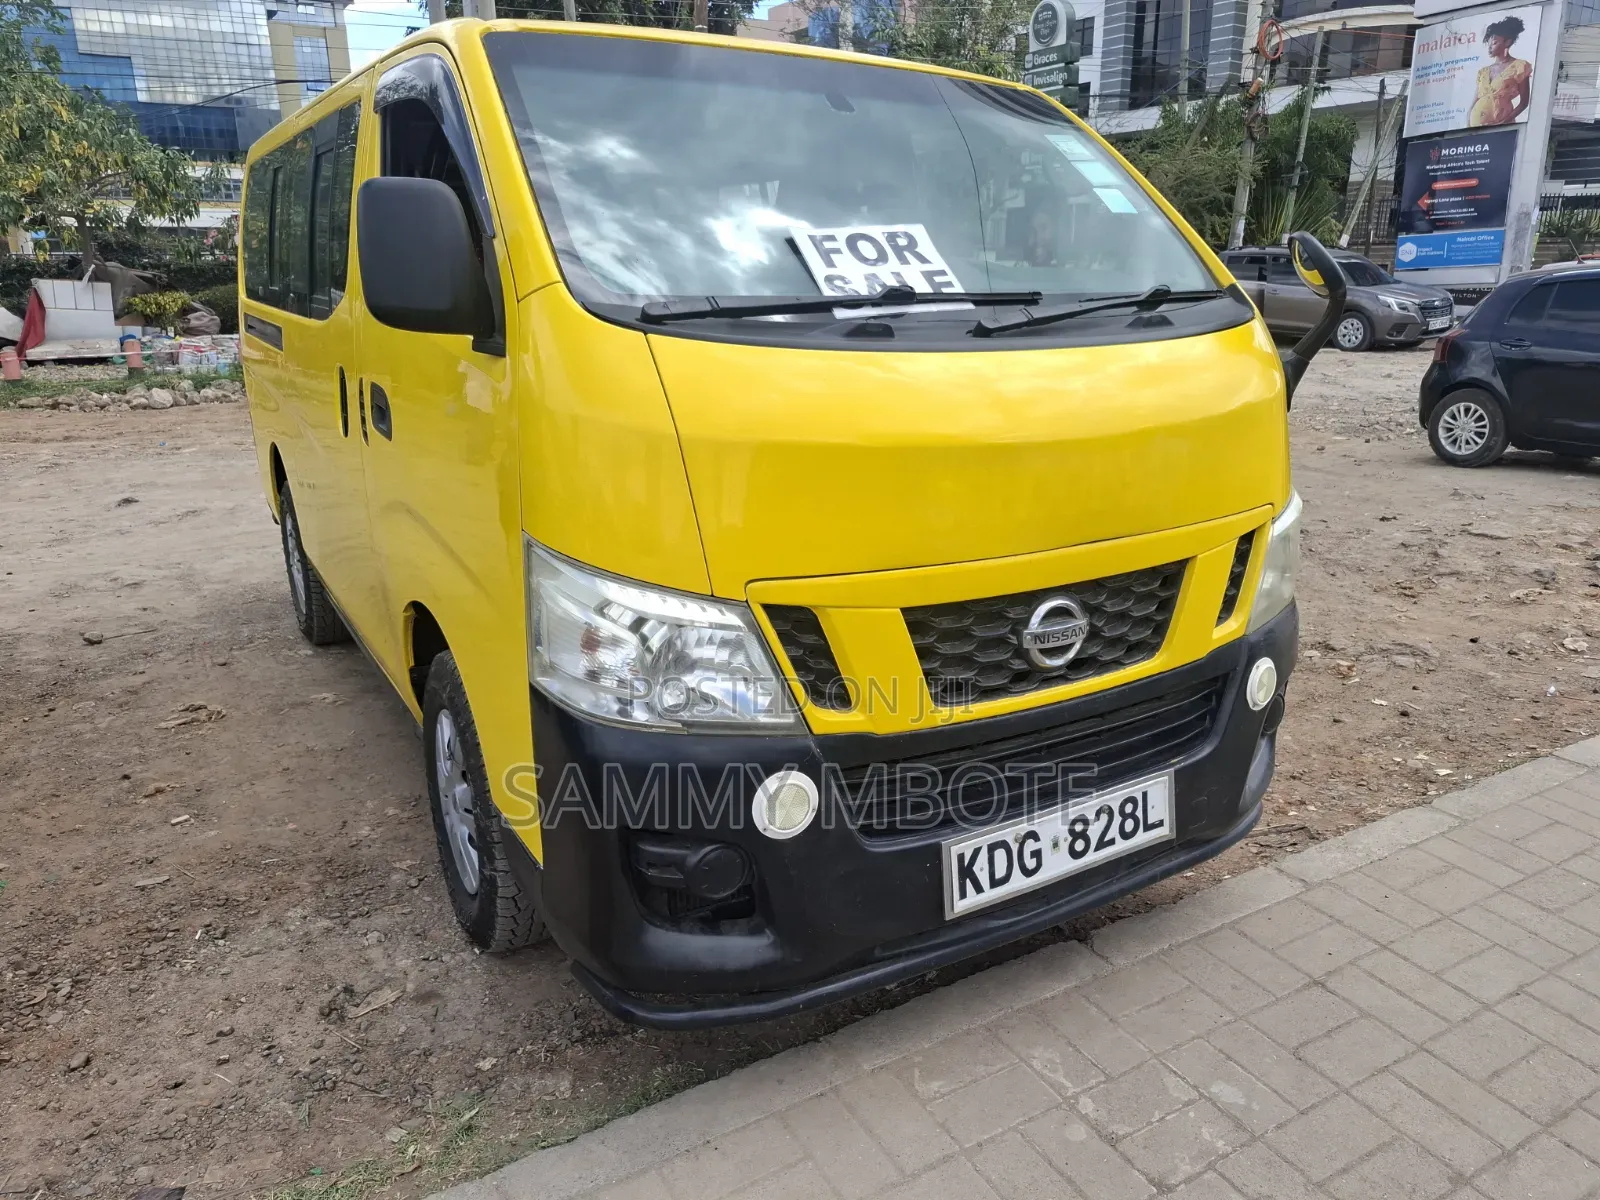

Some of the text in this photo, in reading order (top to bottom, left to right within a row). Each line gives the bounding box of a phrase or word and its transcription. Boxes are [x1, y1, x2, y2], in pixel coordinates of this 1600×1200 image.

[1417, 30, 1476, 54] malaica
[1033, 52, 1058, 66] Braces
[1444, 55, 1480, 66] pregnancy
[1033, 70, 1068, 85] Invisalign
[1441, 144, 1490, 156] MORINGA
[807, 231, 933, 268] FOR
[1034, 624, 1085, 645] NISSAN
[957, 790, 1164, 901] KDG 828L
